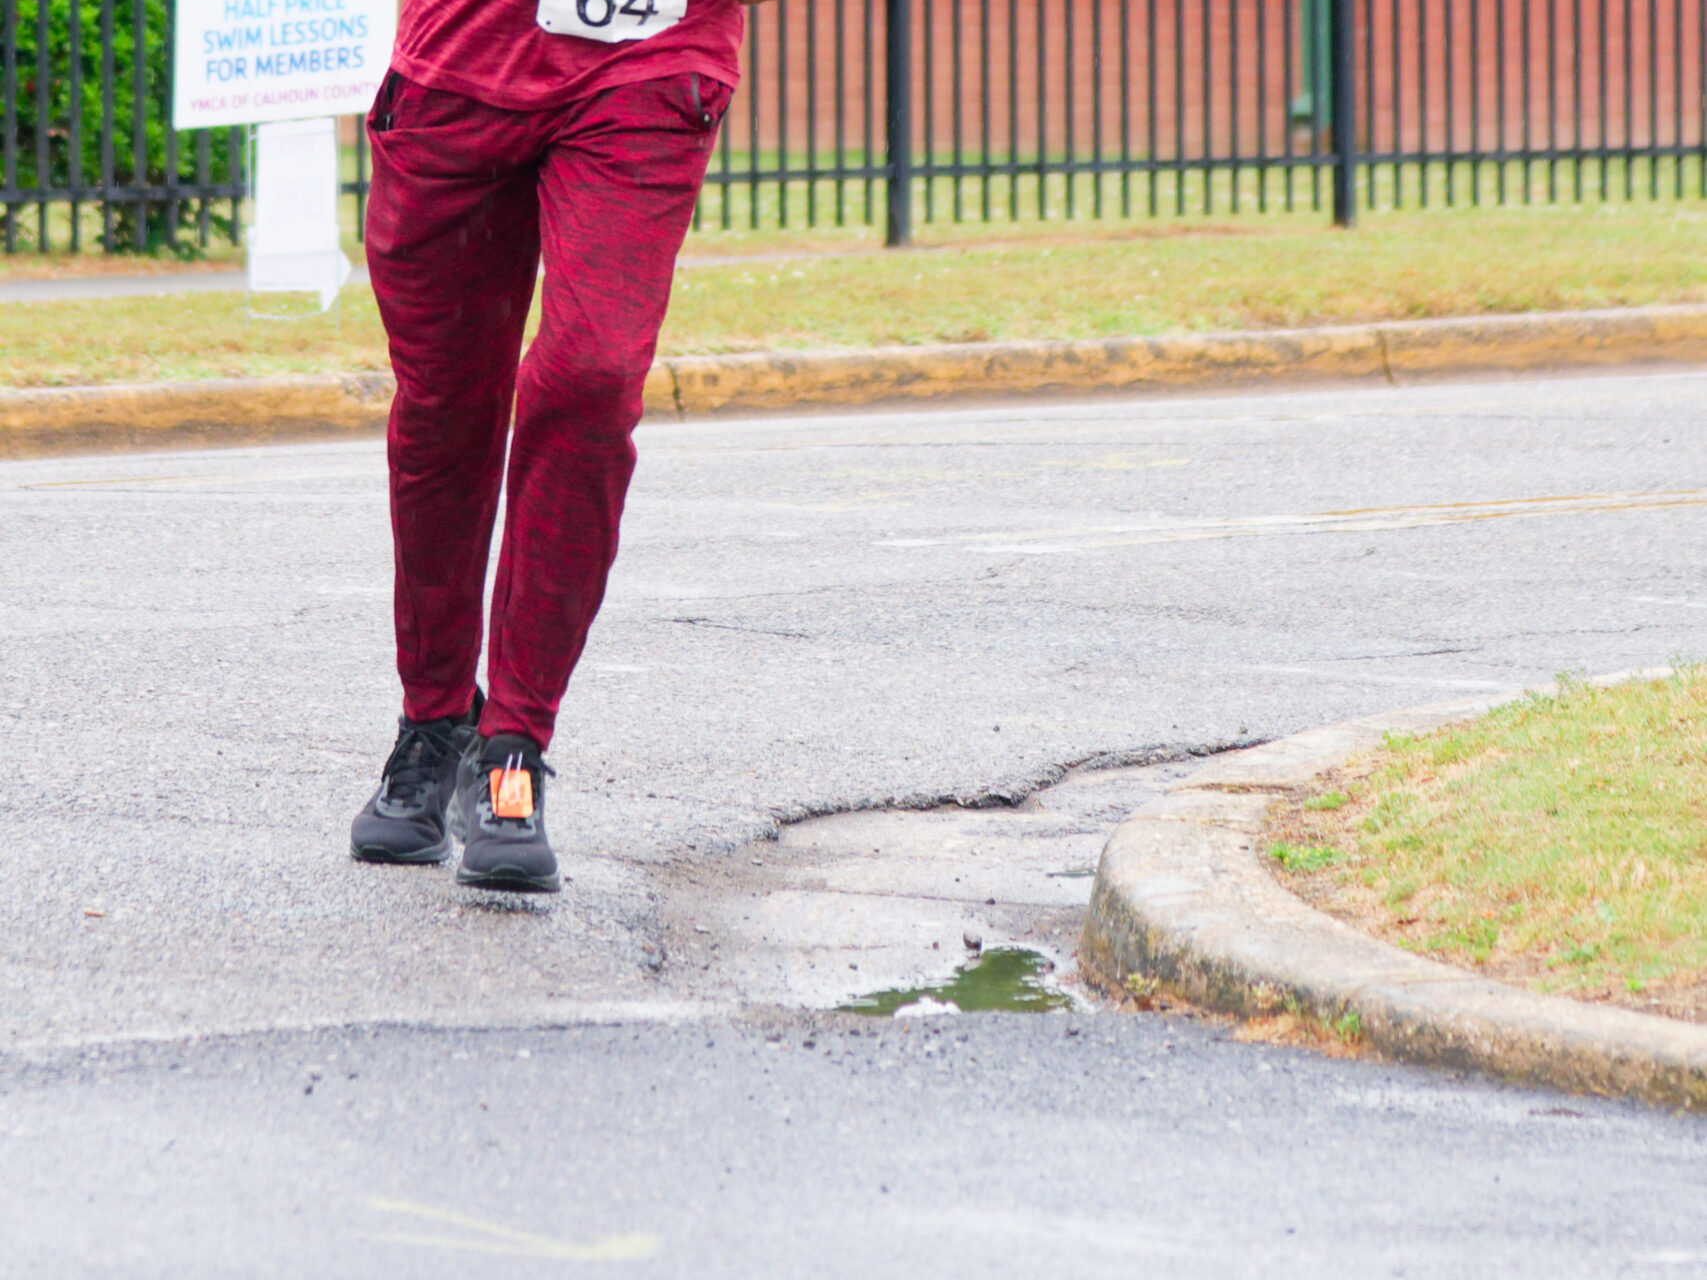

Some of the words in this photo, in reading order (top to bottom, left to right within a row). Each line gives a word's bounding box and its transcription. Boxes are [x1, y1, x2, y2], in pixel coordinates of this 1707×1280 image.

[203, 24, 263, 54] SWIM
[269, 14, 368, 47] LESSONS
[206, 56, 248, 83] FOR
[255, 45, 364, 78] MEMBERS
[190, 95, 227, 112] YMCA
[232, 93, 249, 108] OF
[253, 87, 318, 108] CALHOUN
